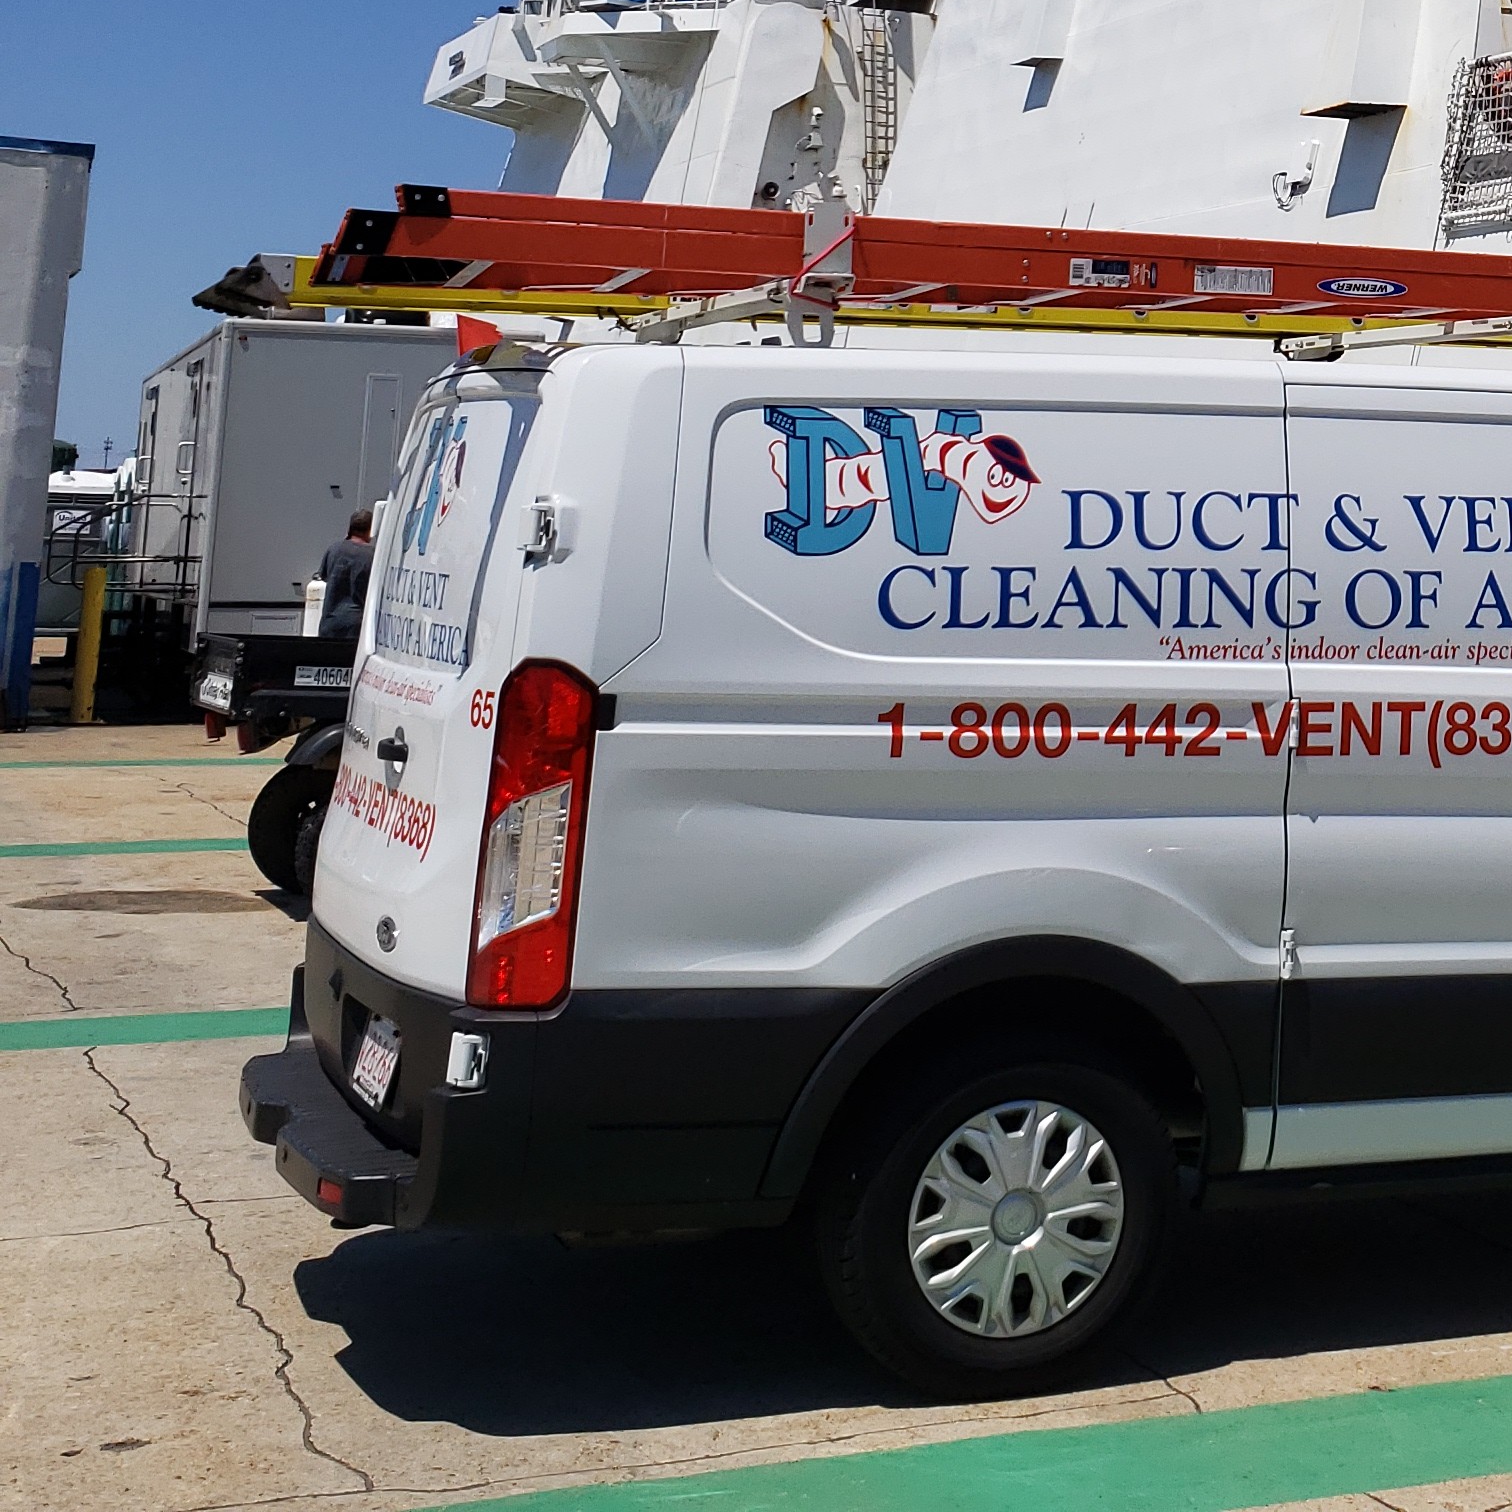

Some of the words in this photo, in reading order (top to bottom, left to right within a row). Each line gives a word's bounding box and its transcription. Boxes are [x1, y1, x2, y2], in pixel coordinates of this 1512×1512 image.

[1335, 281, 1388, 294] WERNER
[1061, 489, 1299, 552] DUCT
[1324, 493, 1387, 552] &
[418, 570, 450, 610] VENT
[877, 565, 1321, 631] CLEANING
[1344, 568, 1442, 630] OF
[1289, 637, 1360, 661] indoor
[1365, 638, 1461, 661] clean-air
[470, 688, 495, 729] 65
